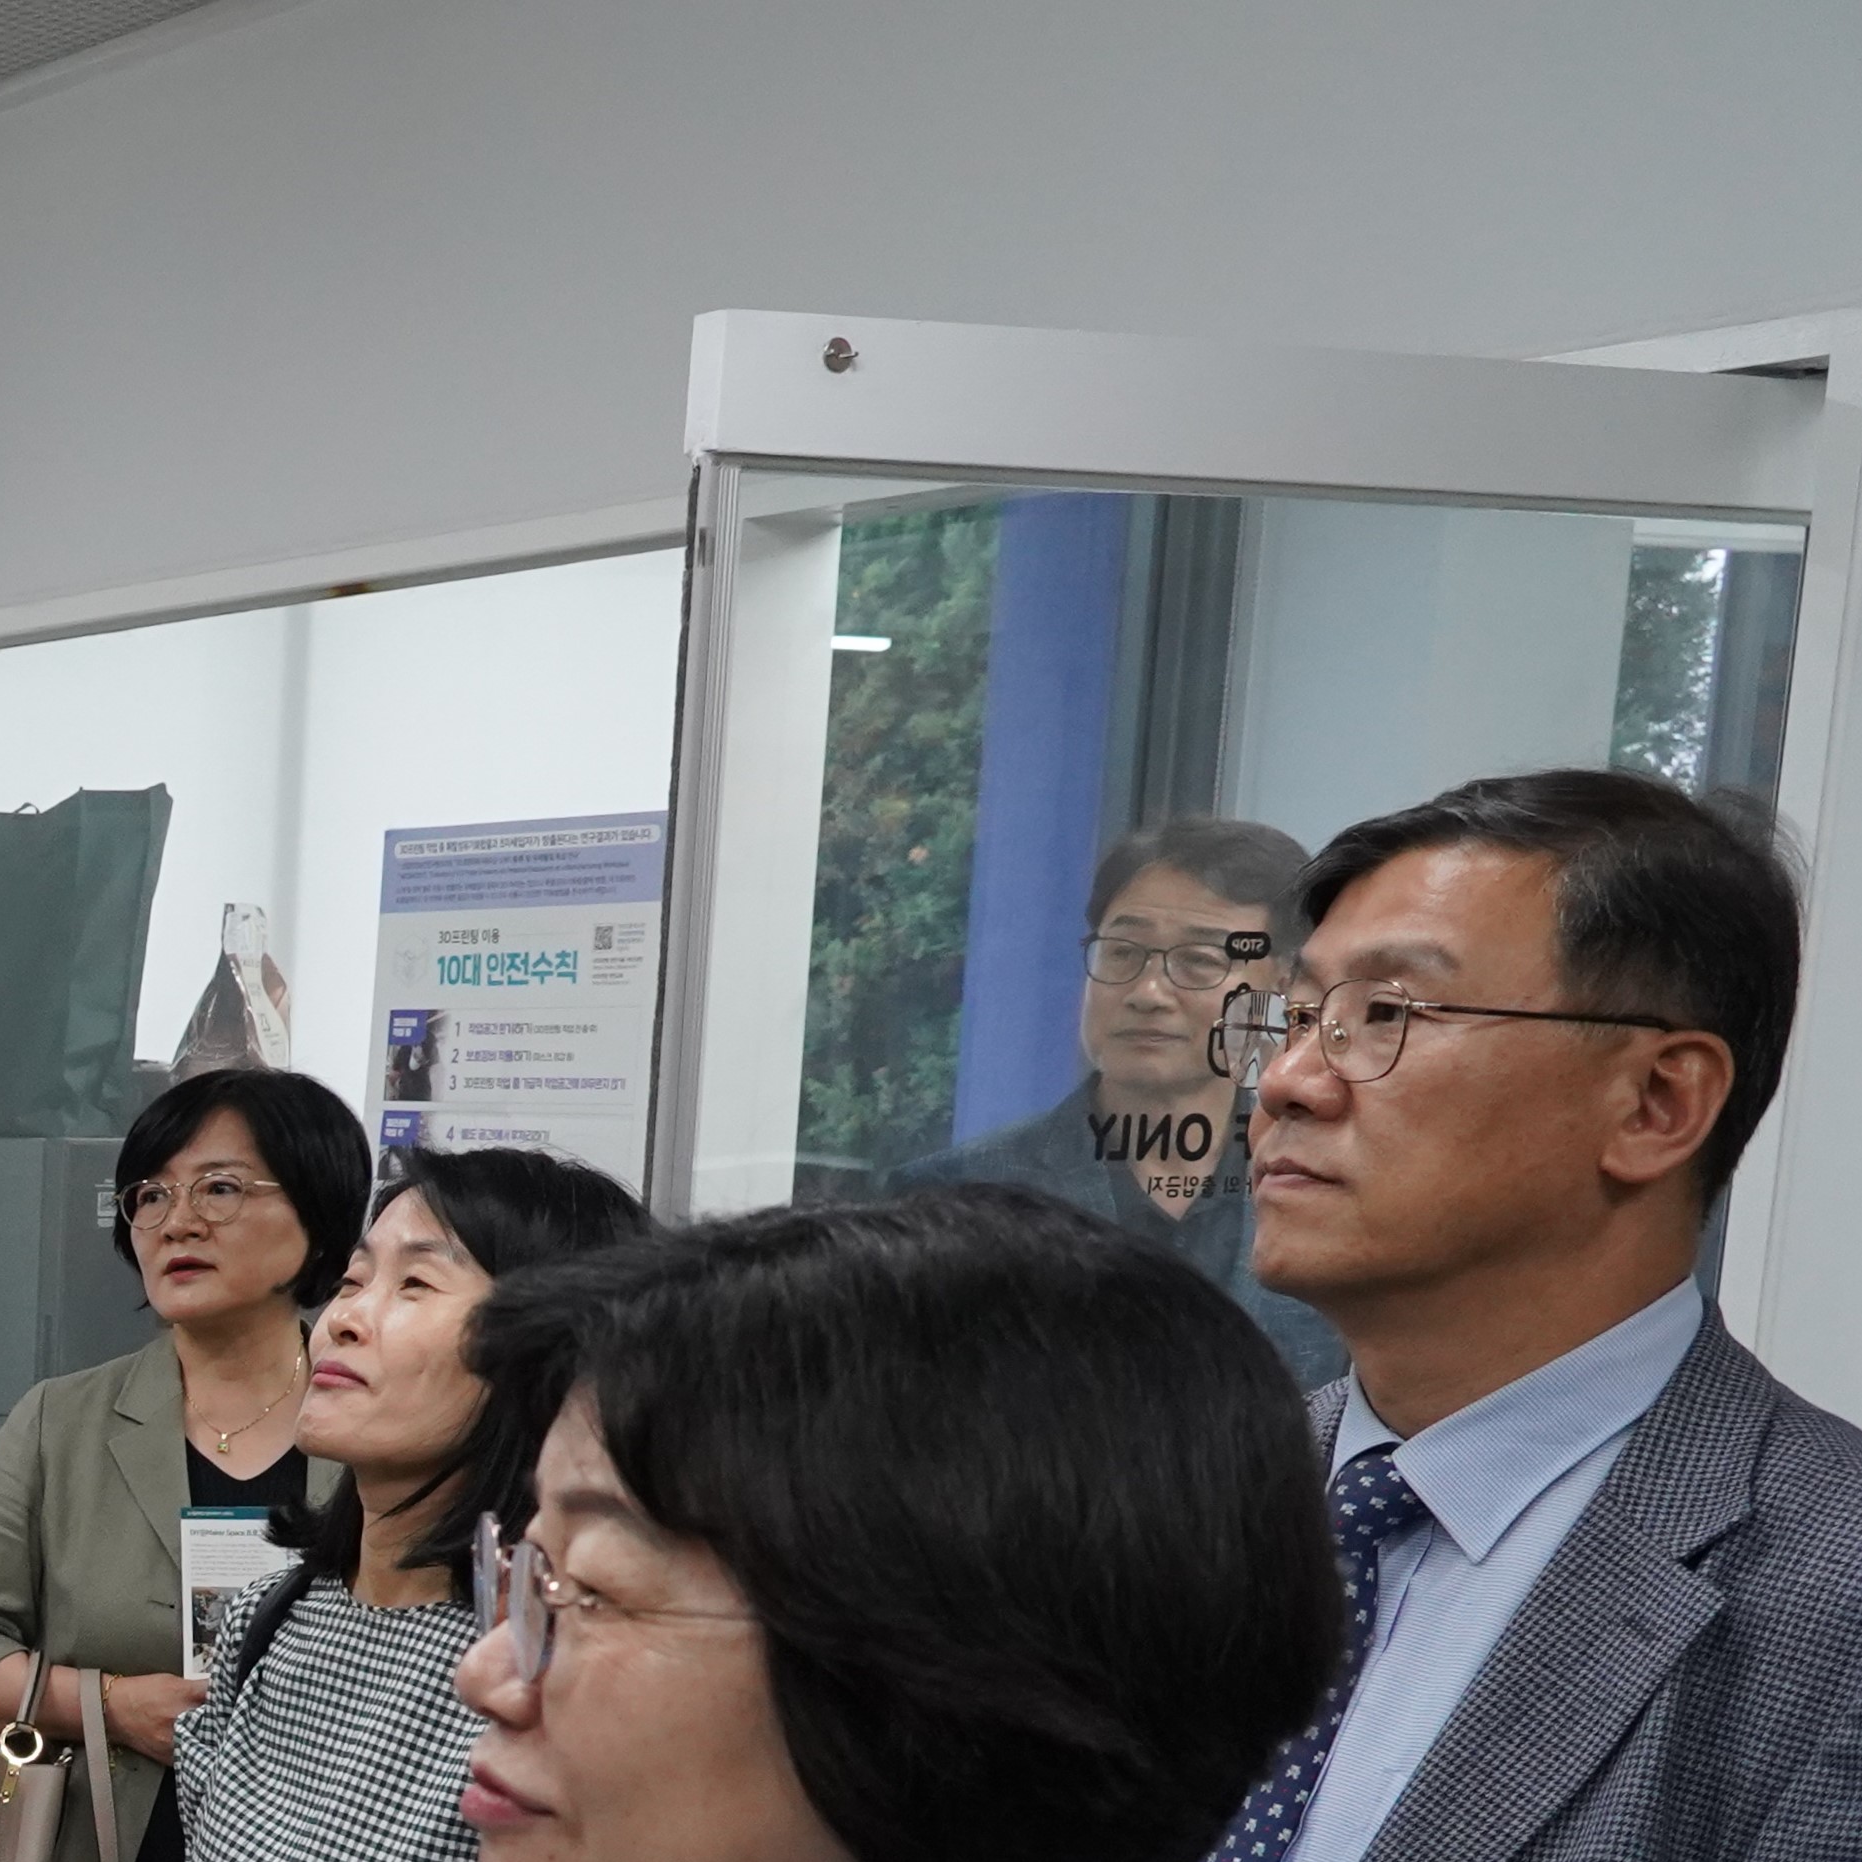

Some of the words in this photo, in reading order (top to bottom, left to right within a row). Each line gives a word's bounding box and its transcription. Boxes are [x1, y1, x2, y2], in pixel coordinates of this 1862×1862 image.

[438, 929, 479, 945] 3D프린팅
[481, 928, 500, 943] 이용
[437, 954, 481, 986] 10대
[486, 950, 578, 986] 안전수칙
[454, 1022, 461, 1037] 1
[451, 1049, 459, 1064] 2
[449, 1075, 457, 1090] 3
[446, 1126, 455, 1142] 4
